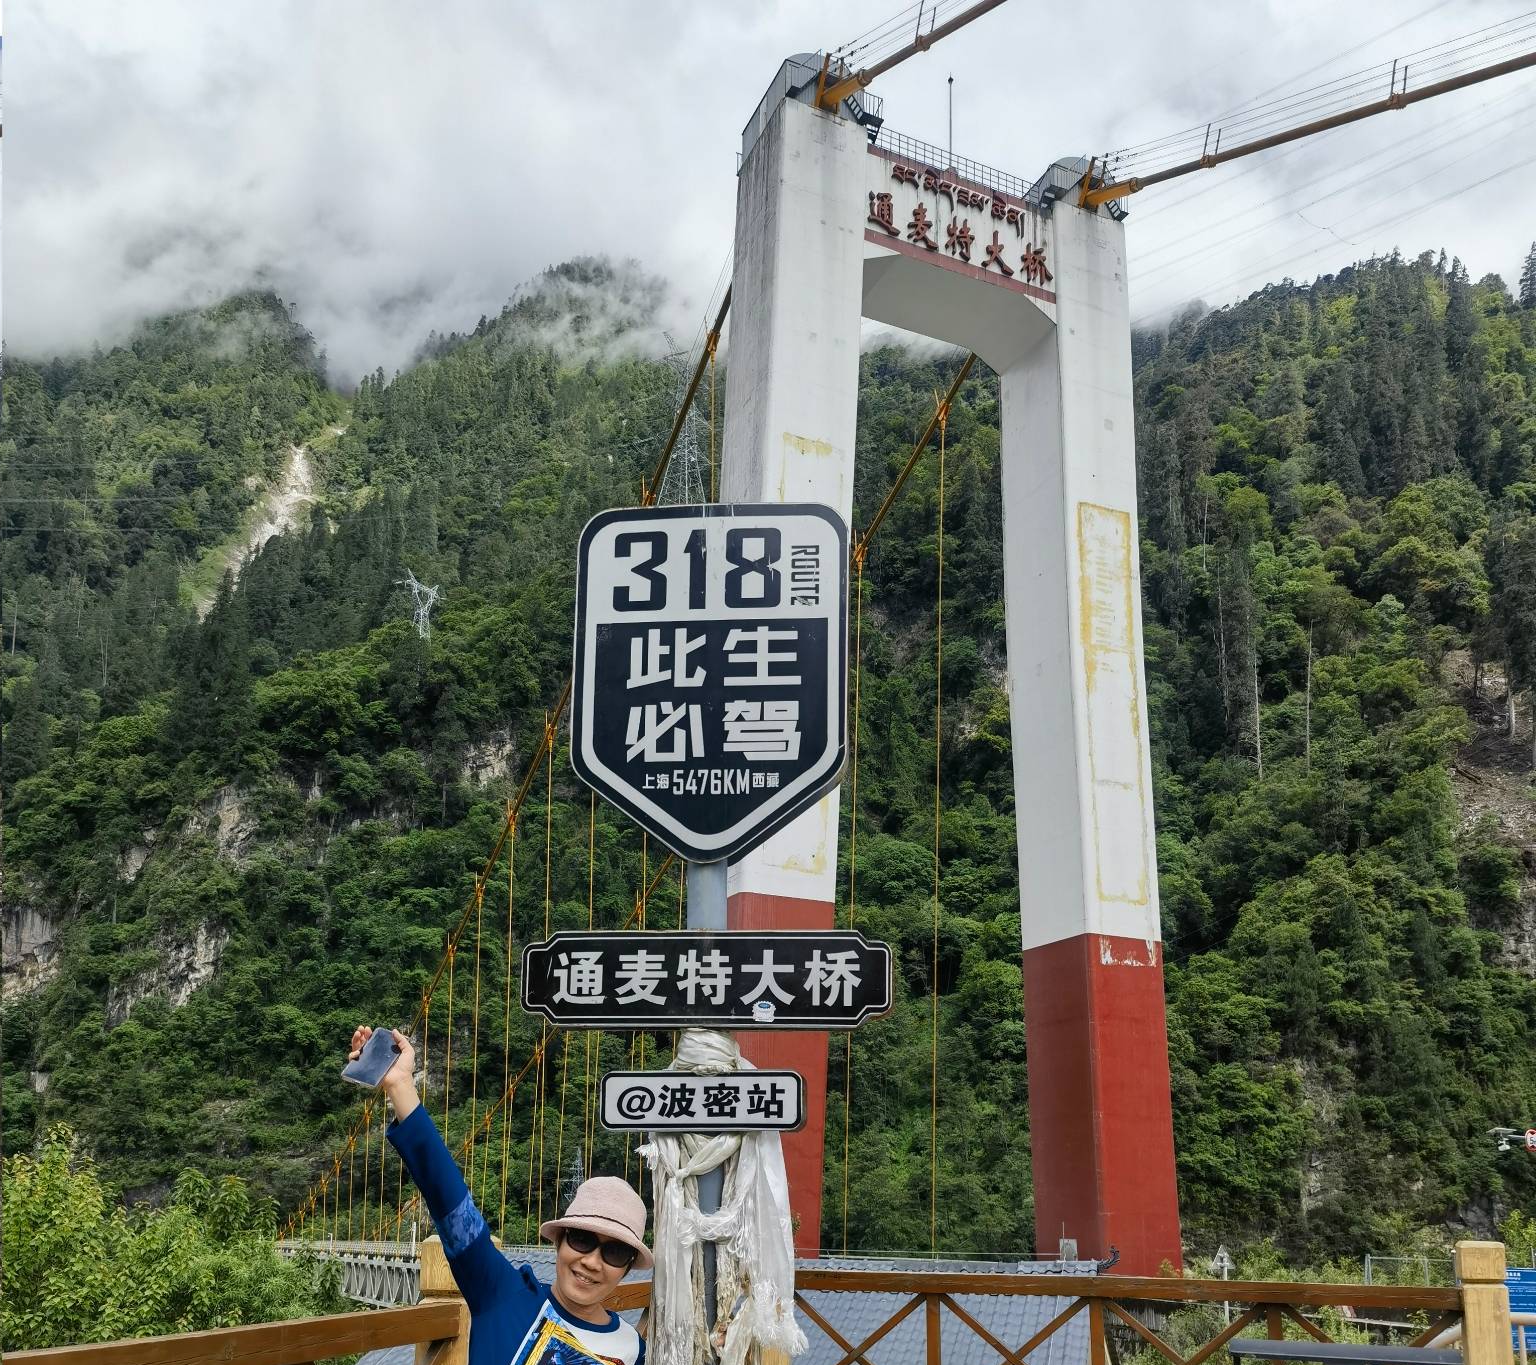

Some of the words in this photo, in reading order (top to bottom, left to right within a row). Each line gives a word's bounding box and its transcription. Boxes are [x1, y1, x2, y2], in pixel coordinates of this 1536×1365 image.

[867, 190, 1053, 287] 通麦特大桥
[612, 527, 782, 612] 318
[791, 545, 819, 606] ROUTE
[626, 627, 802, 691] 此生
[625, 700, 802, 763] 必驾
[552, 949, 863, 1009] 通麦特大桥
[616, 1082, 786, 1120] @波密站
